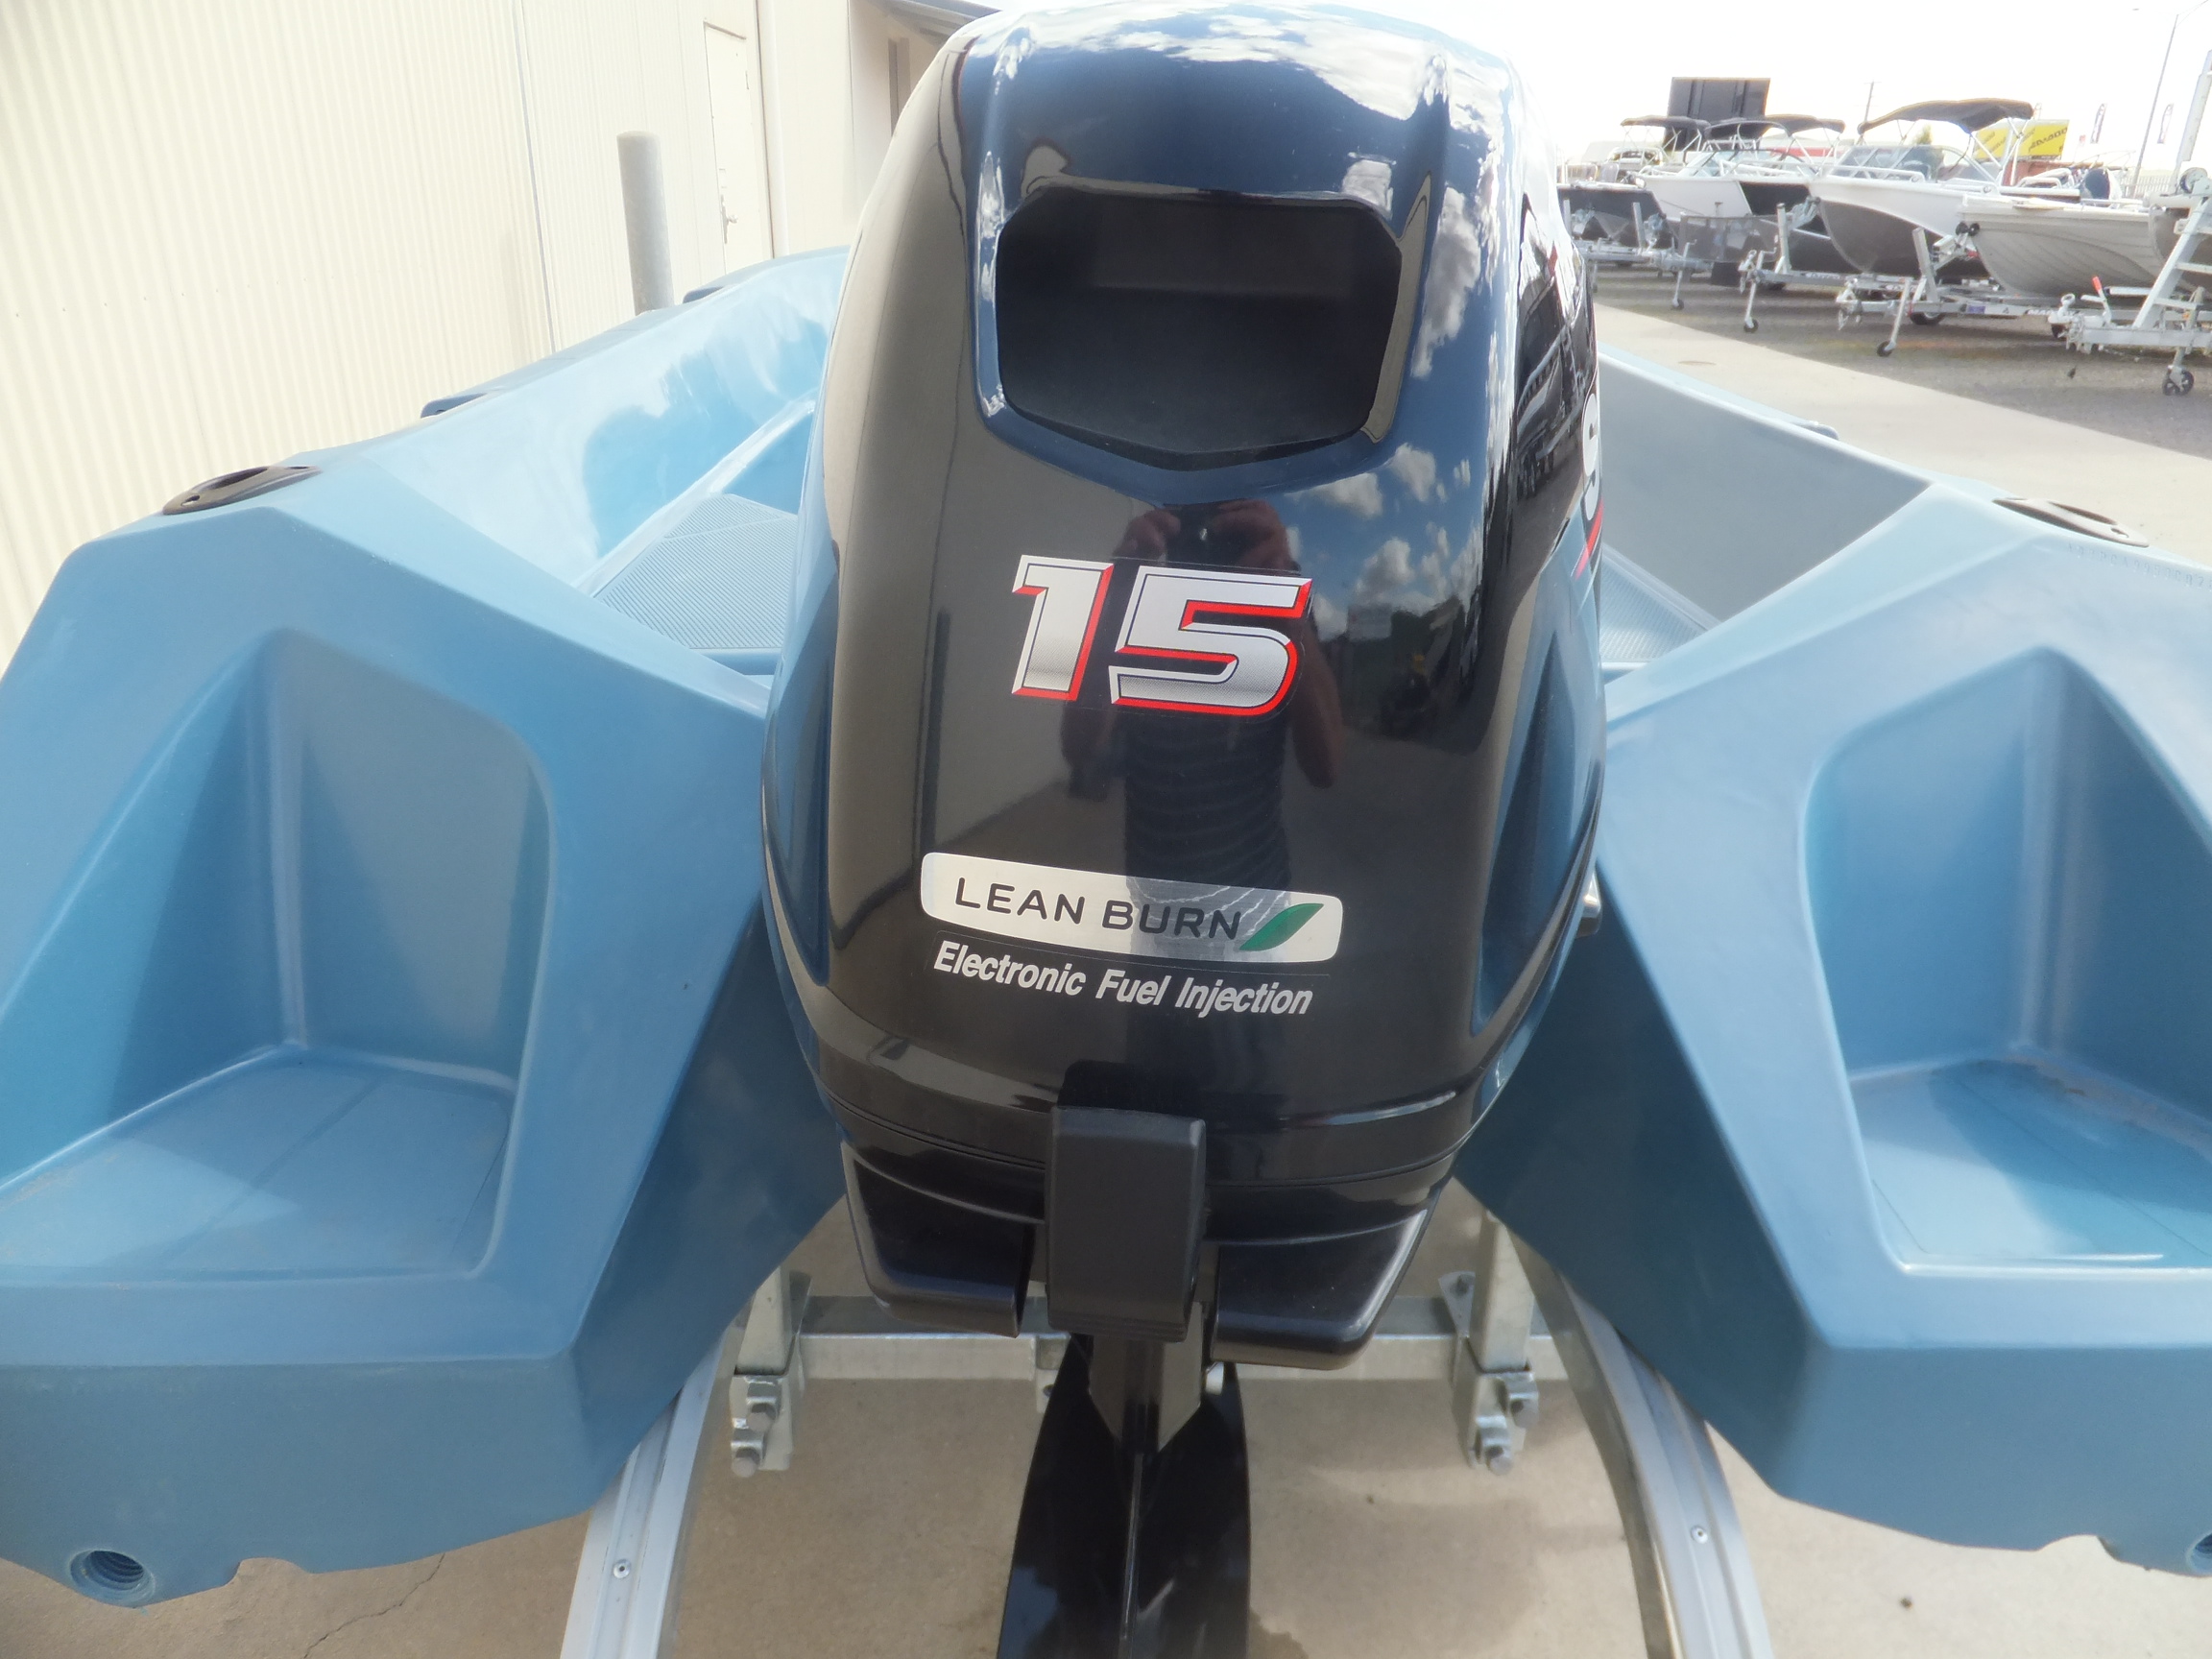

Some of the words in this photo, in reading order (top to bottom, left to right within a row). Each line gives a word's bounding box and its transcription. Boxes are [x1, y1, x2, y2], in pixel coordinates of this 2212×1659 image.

[1012, 554, 1312, 716] 15
[954, 877, 1086, 926] LEAN
[1101, 899, 1242, 941] BURN
[933, 940, 1087, 996] Electronic
[1094, 969, 1172, 1006] Fuel
[1174, 976, 1313, 1018] Injection
